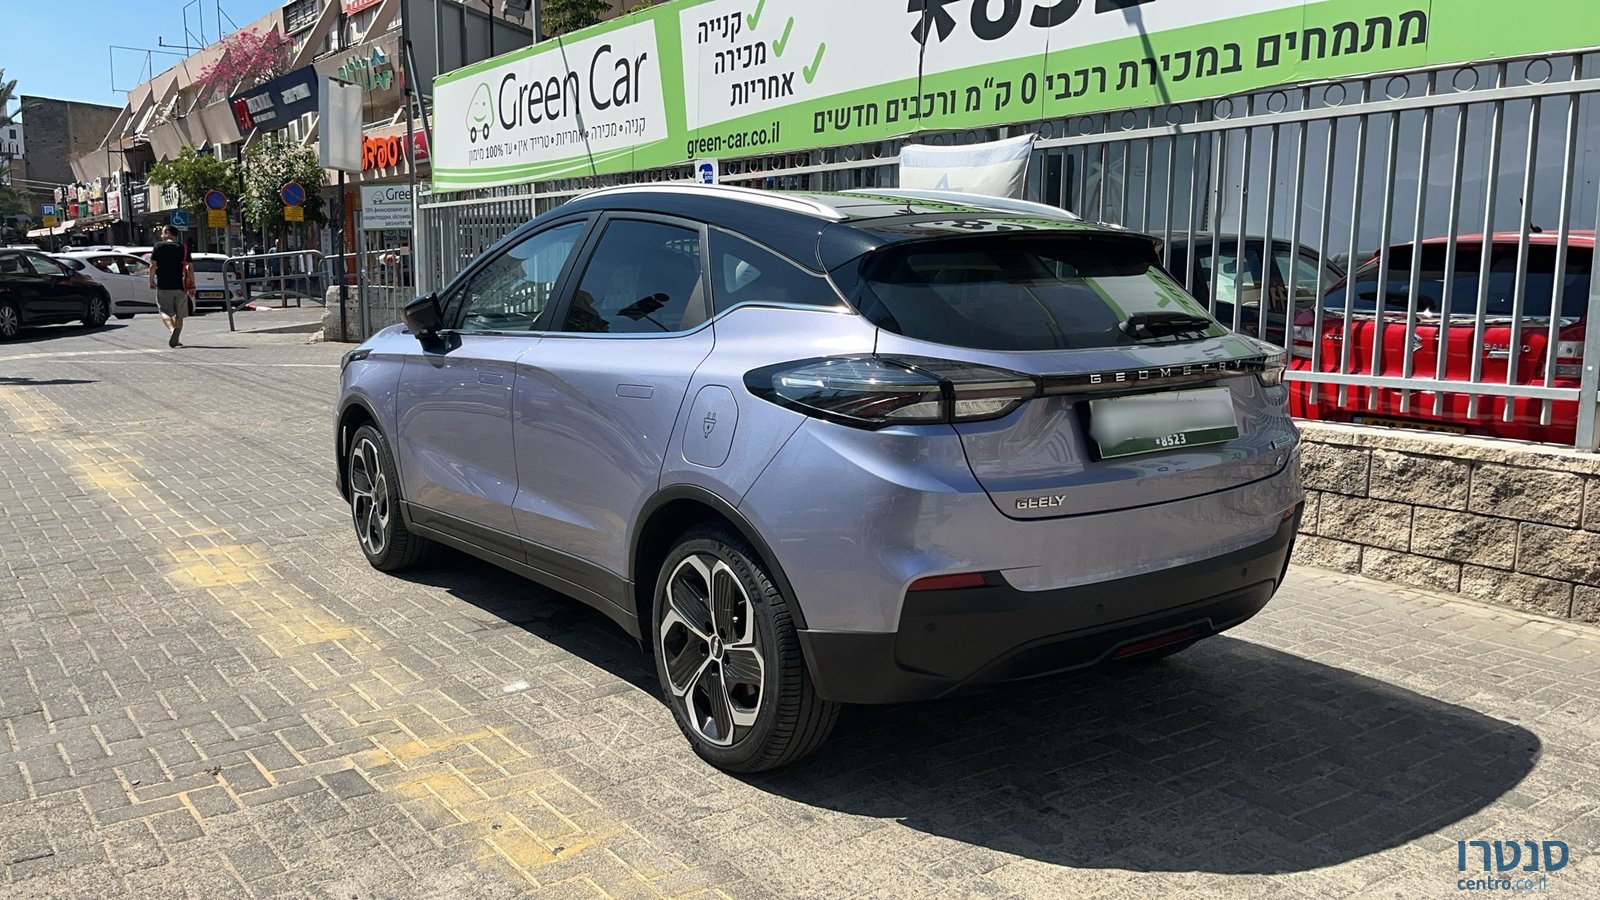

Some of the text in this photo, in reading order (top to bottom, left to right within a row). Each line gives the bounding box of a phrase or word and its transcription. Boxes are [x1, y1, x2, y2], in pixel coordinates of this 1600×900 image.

[698, 11, 742, 44] קנייה
[1256, 9, 1428, 69] מתמחים
[714, 41, 767, 75] מכירה
[1115, 42, 1242, 91] במכירת
[498, 44, 648, 130] Green Car
[730, 71, 795, 107] אחריות
[1020, 72, 1037, 105] 0
[1045, 66, 1107, 100] רכבי
[813, 103, 878, 134] חדשים
[885, 89, 956, 123] ורכבים
[556, 128, 585, 146] אחריות
[591, 122, 617, 140] מכירה
[625, 117, 646, 137] קניה
[687, 120, 780, 159] green-car.co.il
[485, 143, 504, 159] 100%
[385, 187, 412, 201] Gree
[1090, 359, 1241, 384] GEOMETRY
[1015, 494, 1067, 510] GEELY
